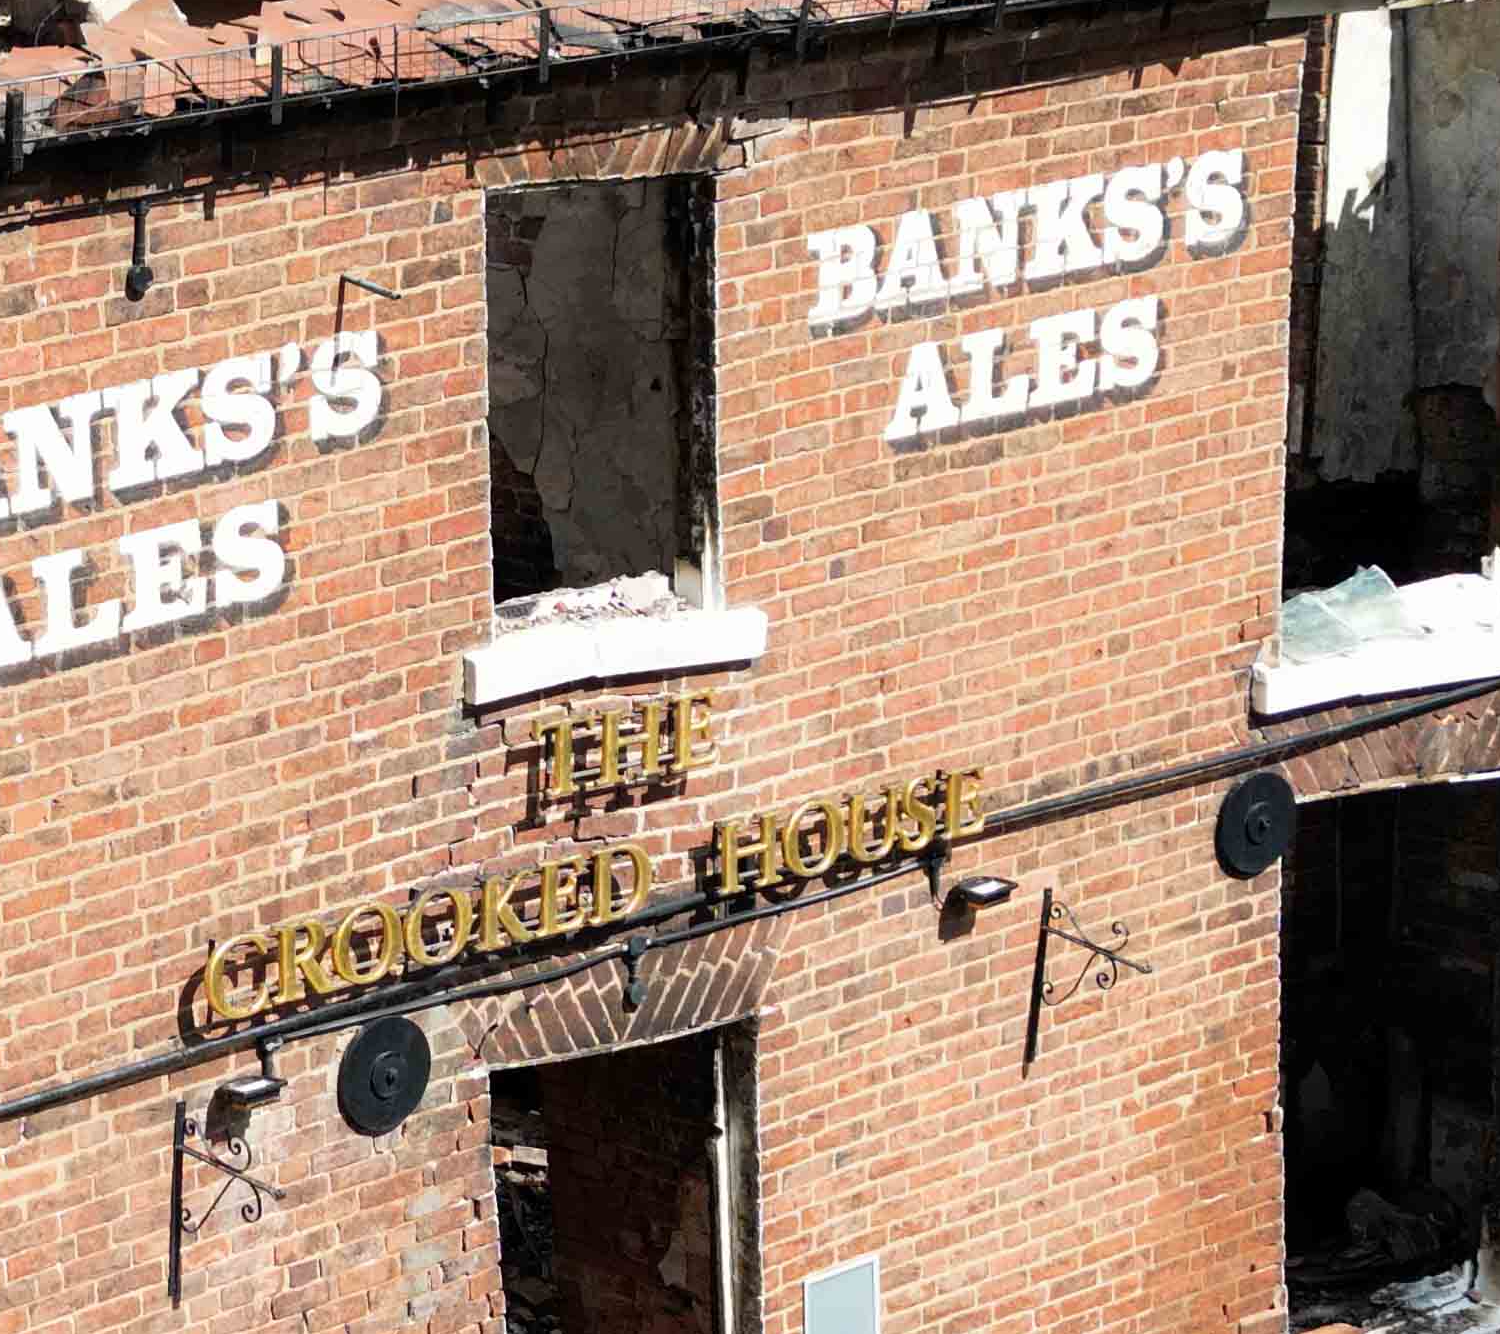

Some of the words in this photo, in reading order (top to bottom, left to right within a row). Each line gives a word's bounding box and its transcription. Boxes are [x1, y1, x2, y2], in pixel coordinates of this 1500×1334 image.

[808, 148, 1246, 324] BANKS'S
[884, 295, 1160, 443] ALES
[532, 687, 720, 798] THE
[205, 843, 653, 1020] CROOKED
[720, 768, 985, 894] HOUSE
